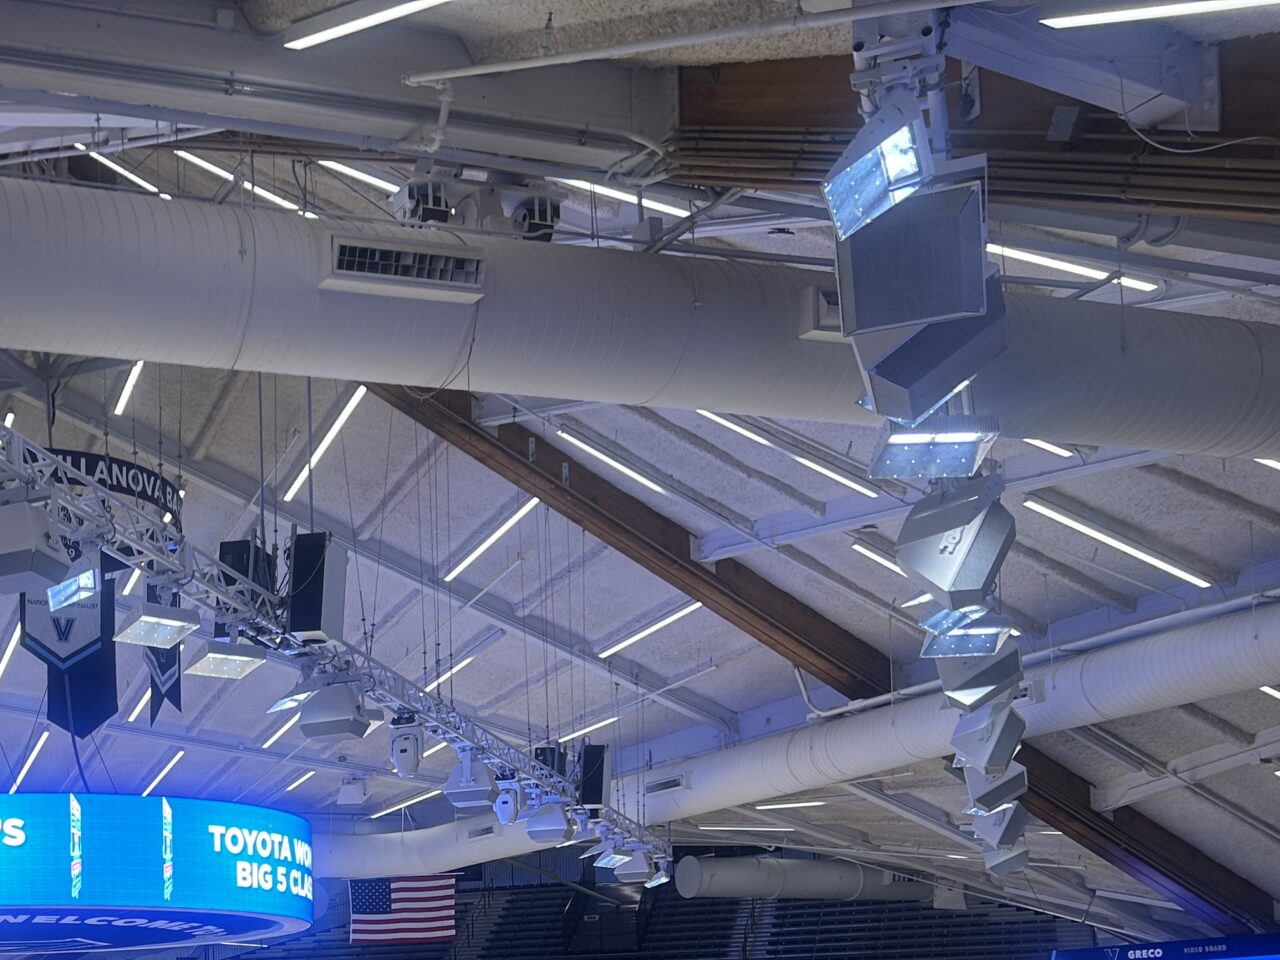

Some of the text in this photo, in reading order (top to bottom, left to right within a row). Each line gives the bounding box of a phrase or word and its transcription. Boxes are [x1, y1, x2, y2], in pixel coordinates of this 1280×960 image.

[208, 824, 292, 862] TOYOTA
[237, 860, 274, 891] BIG
[276, 865, 287, 893] 5
[1127, 948, 1164, 960] GRECO
